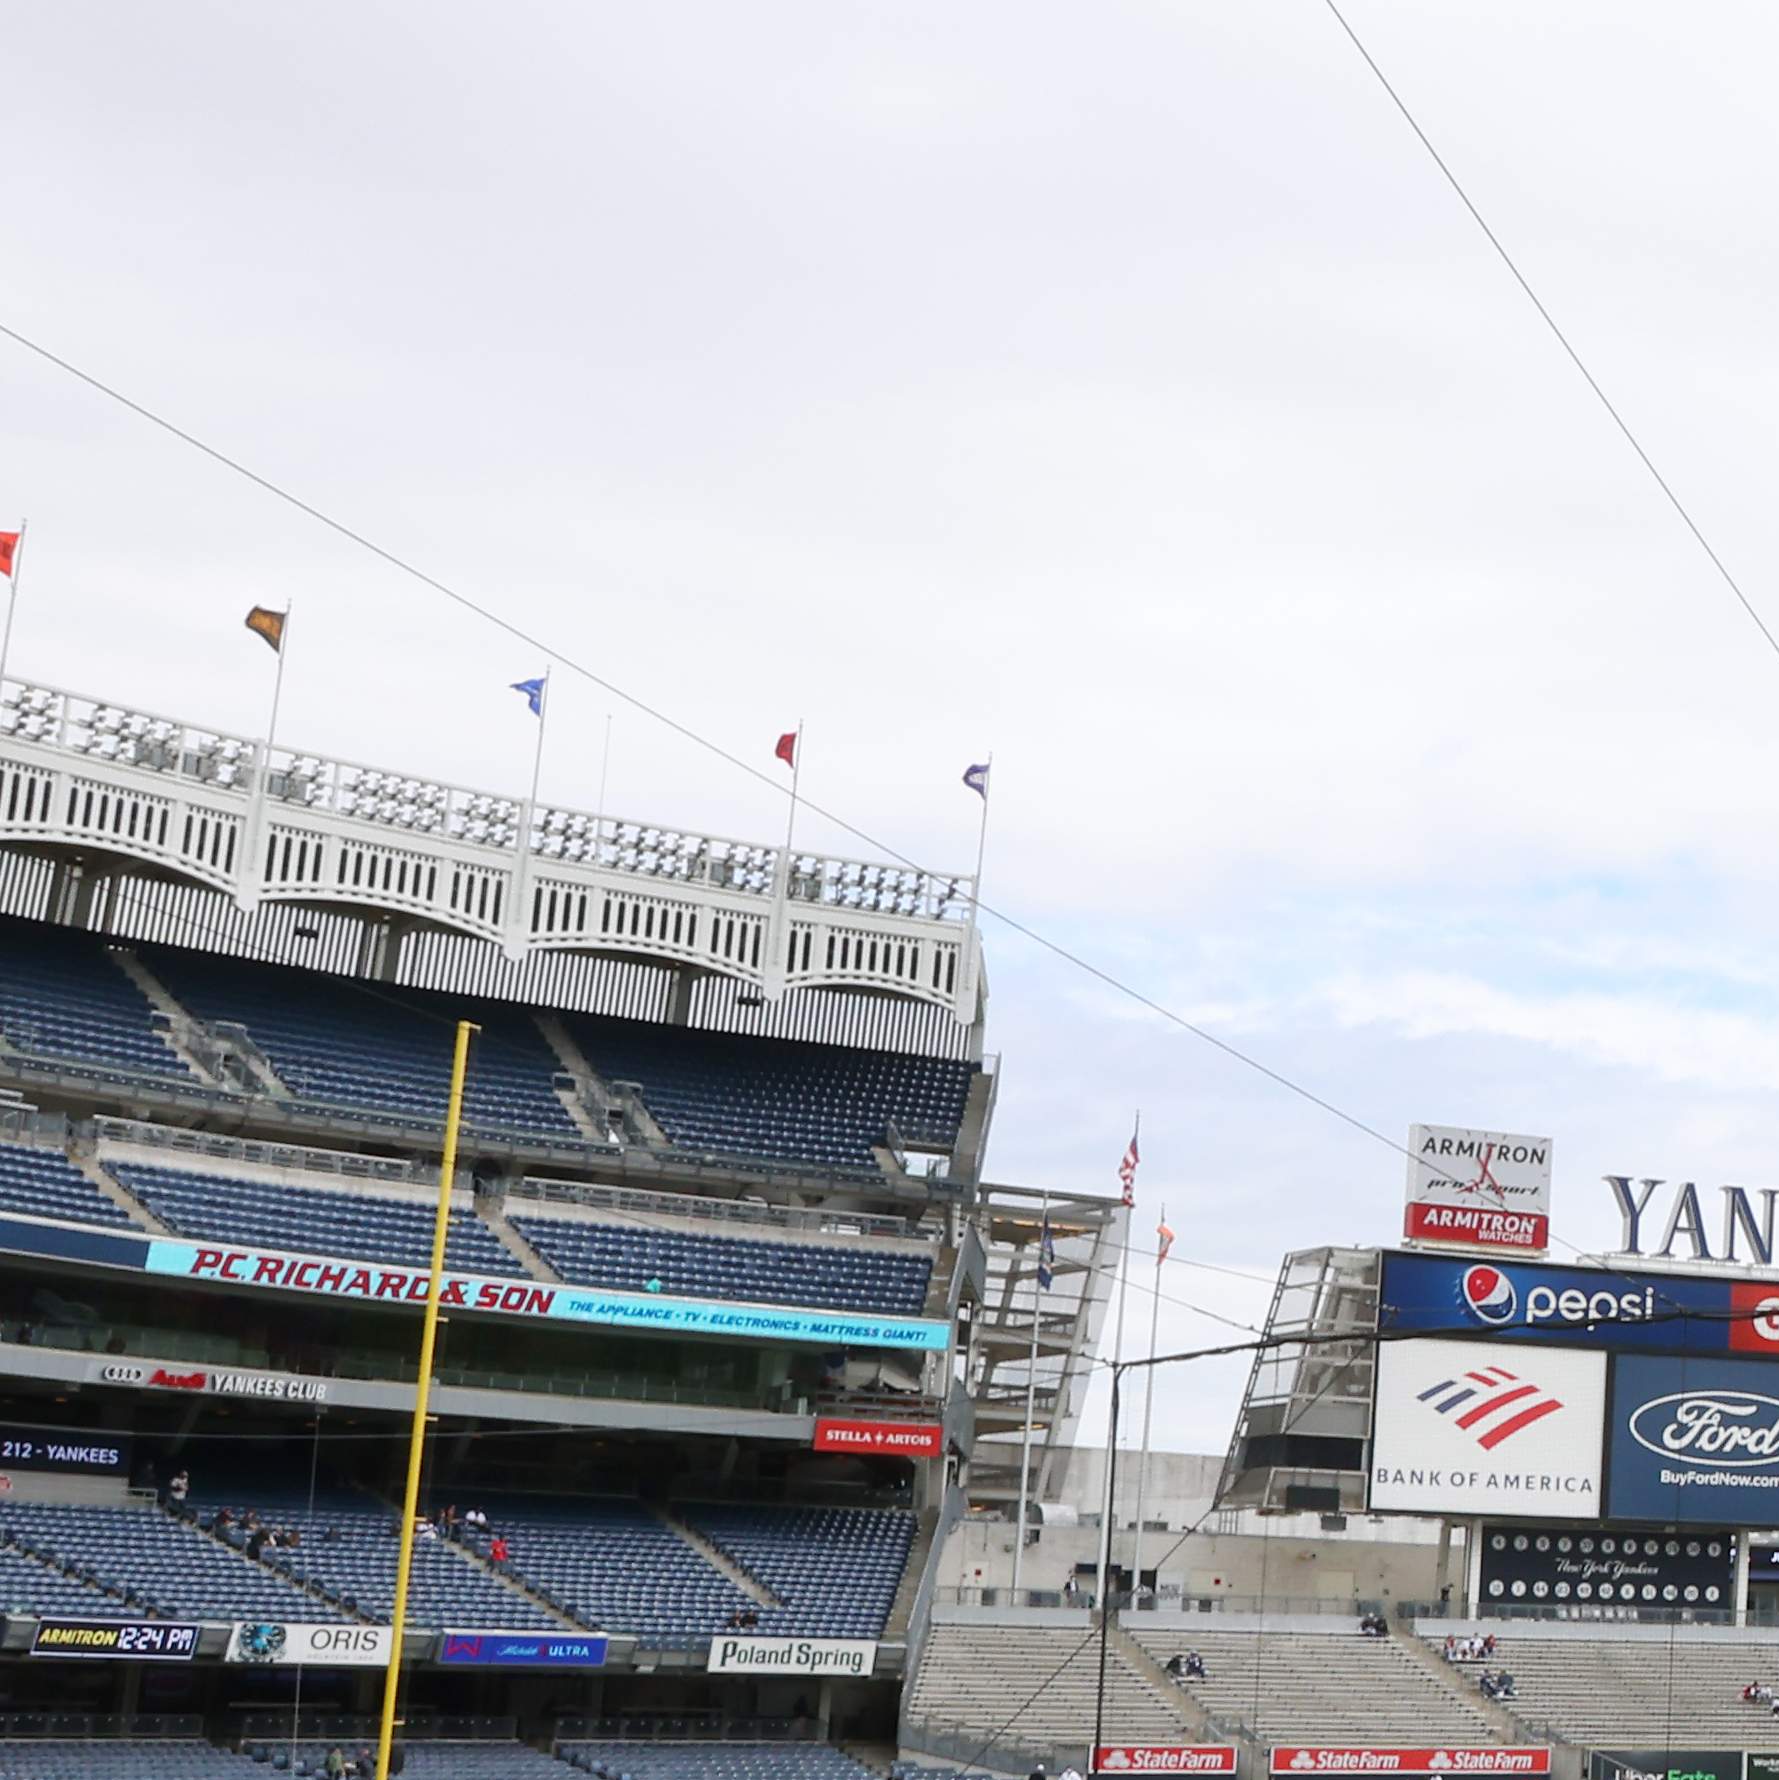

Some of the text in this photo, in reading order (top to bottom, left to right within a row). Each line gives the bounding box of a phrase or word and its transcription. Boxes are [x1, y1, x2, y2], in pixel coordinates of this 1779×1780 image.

[1422, 1137, 1546, 1165] ARMITRON
[1423, 1208, 1535, 1234] ARMITRON
[1478, 1229, 1534, 1245] WATCHES
[189, 1249, 556, 1314] P.C. RICHARD & SON
[1525, 1284, 1655, 1332] pepsi
[569, 1300, 929, 1343] THE APPLIANCE ELECTRONICS MATTRESS GIANT!
[148, 1369, 328, 1400] Audi YANKEES CLUB
[825, 1429, 933, 1447] STELLA ARTOIS
[2, 1441, 119, 1465] 212 YANKEES
[1376, 1466, 1594, 1493] BANK OF AMERICA
[38, 1626, 194, 1651] ARMITRON 12:24 PM
[310, 1628, 380, 1653] ORIS
[548, 1645, 590, 1659] ULTRA
[719, 1640, 865, 1675] Poland Spring
